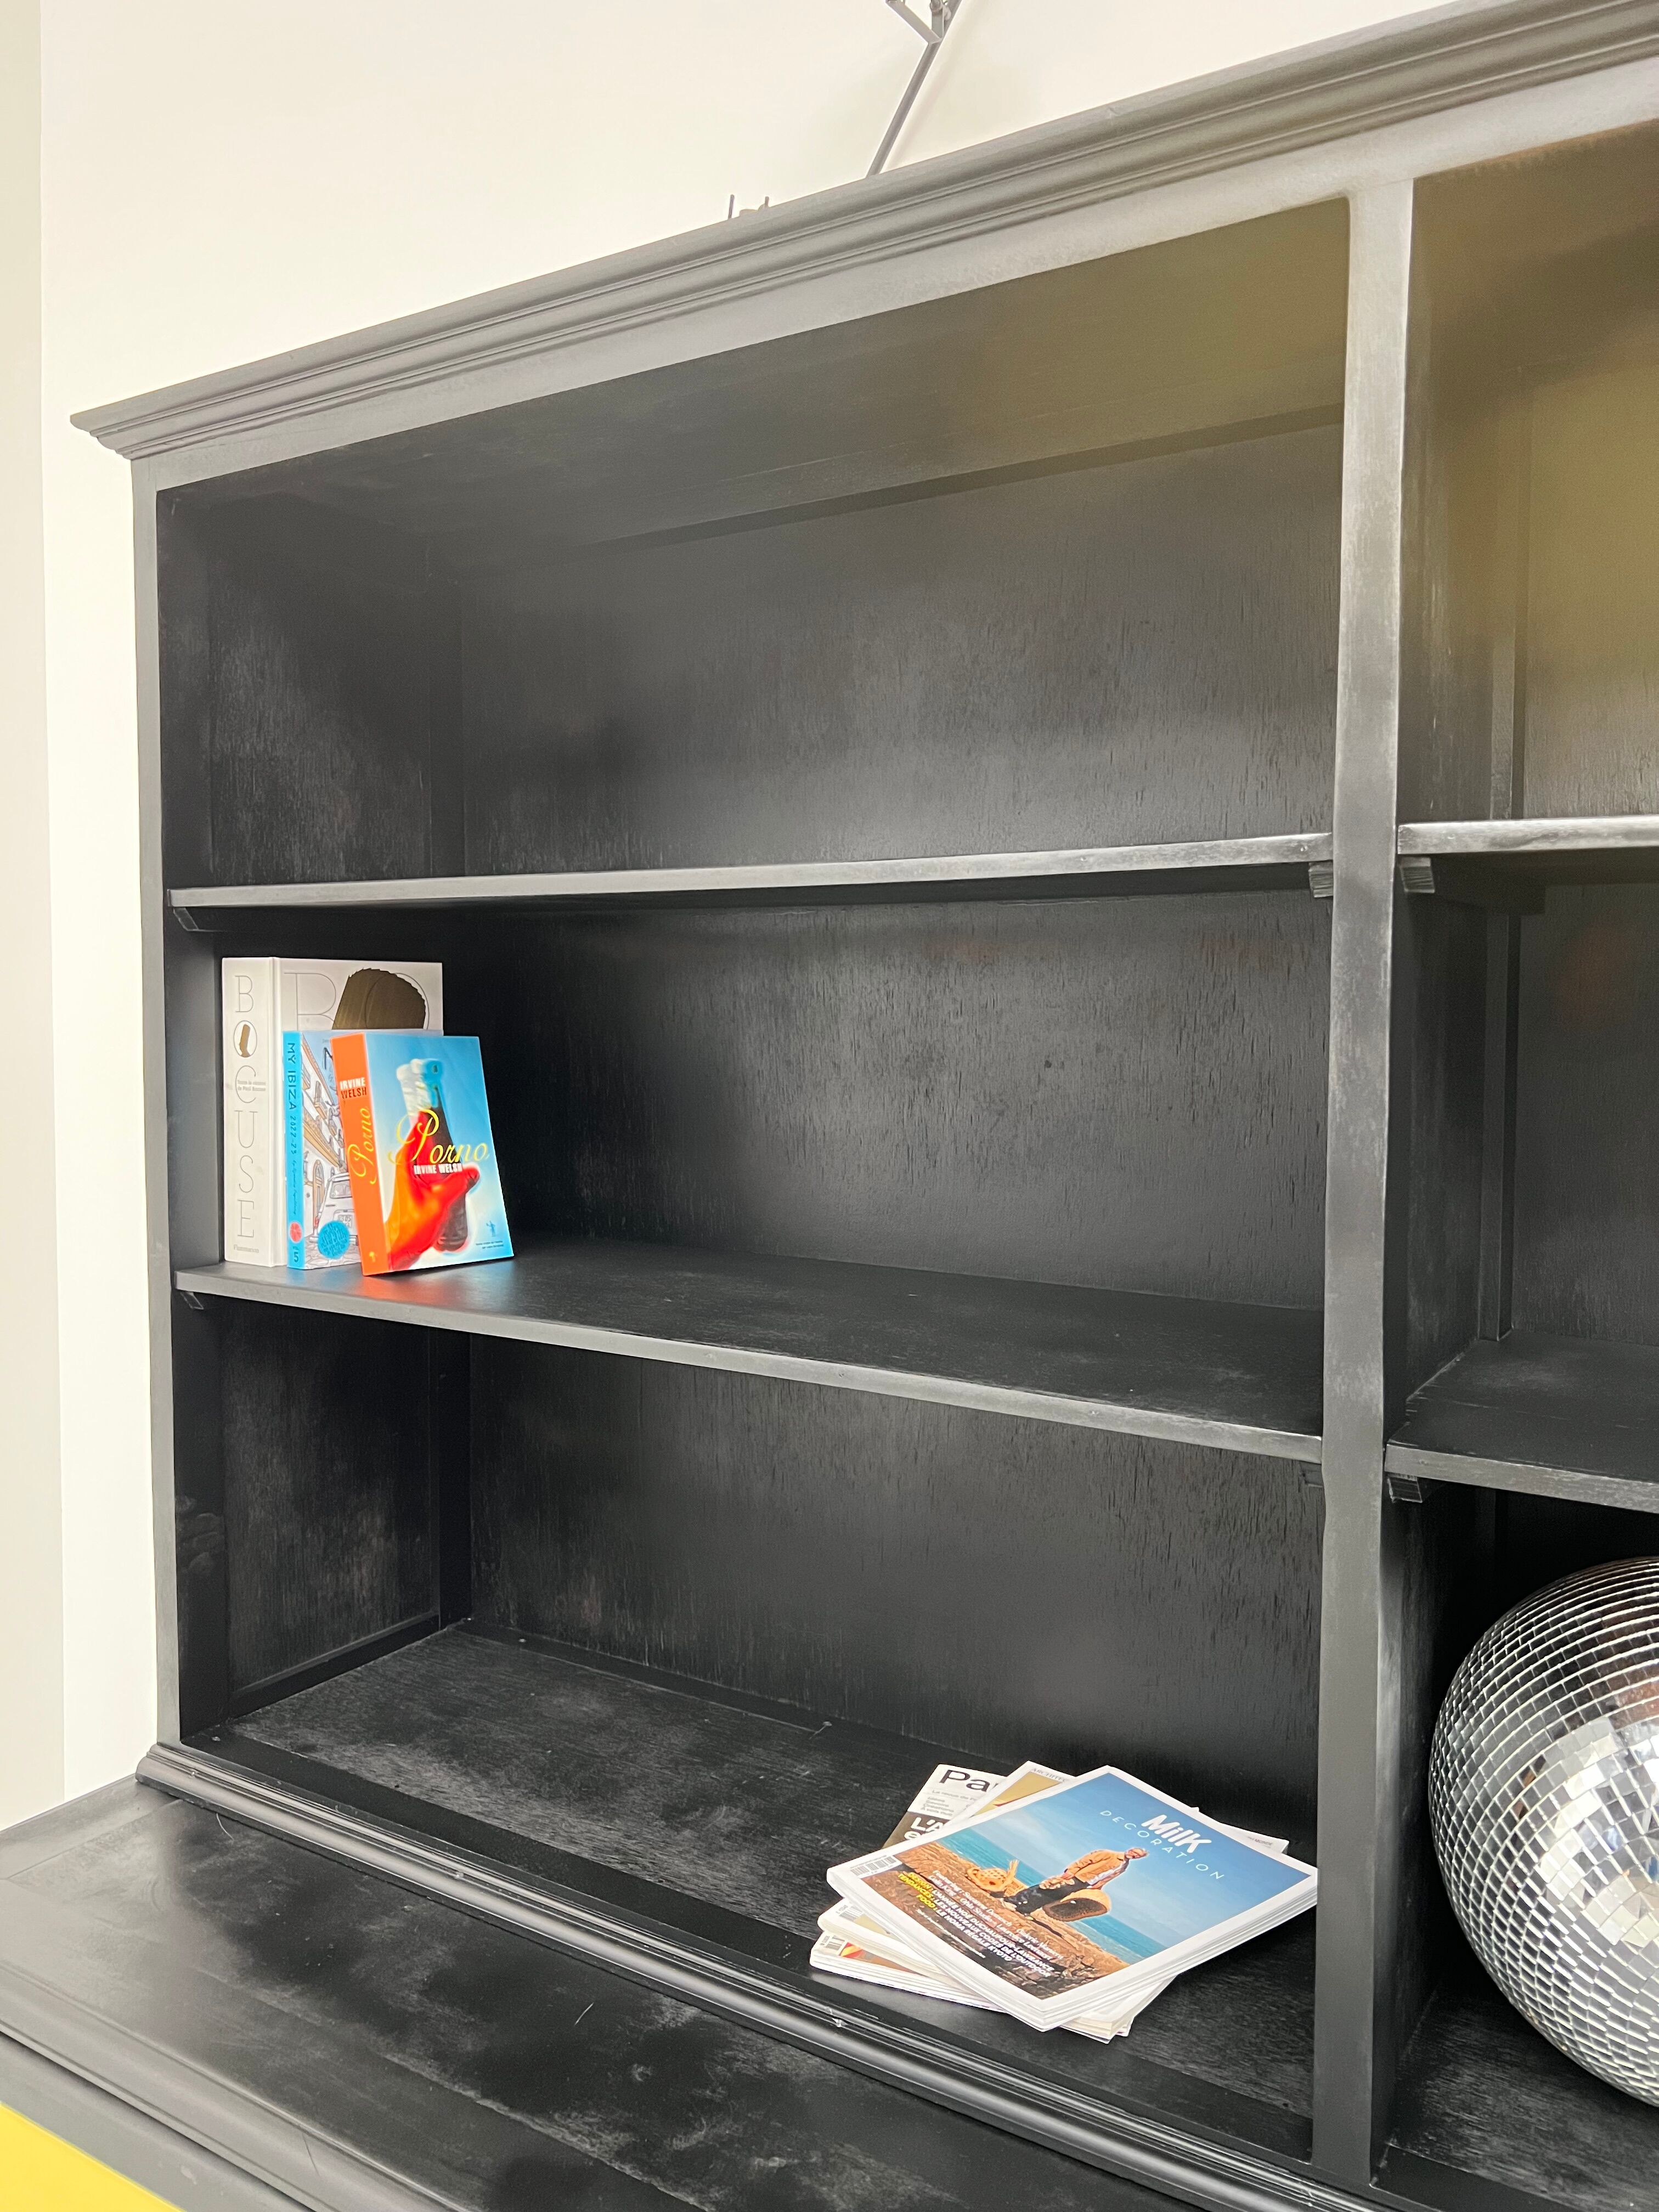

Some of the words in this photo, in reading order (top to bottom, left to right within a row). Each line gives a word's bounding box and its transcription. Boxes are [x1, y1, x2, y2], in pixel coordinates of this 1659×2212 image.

[287, 1070, 297, 1110] IBIZA
[340, 1077, 366, 1090] IRVINE
[341, 1086, 367, 1099] WELSH
[347, 1105, 377, 1185] Porno
[387, 1108, 490, 1165] Porno
[414, 1164, 437, 1175] IRVINE
[438, 1162, 463, 1174] WELSH
[939, 1769, 999, 1793] Pa
[1099, 1810, 1226, 1880] DECORATION
[907, 1872, 932, 1889] DESIGN
[898, 1873, 934, 1898] TENDANCES
[934, 1899, 948, 1909] LES
[945, 1908, 981, 1933] NOUVEAUX
[979, 1932, 1005, 1948] CODES
[916, 1894, 936, 1908] FOOD
[944, 1915, 966, 1931] NOMA
[988, 1945, 1013, 1961] KYOTO
